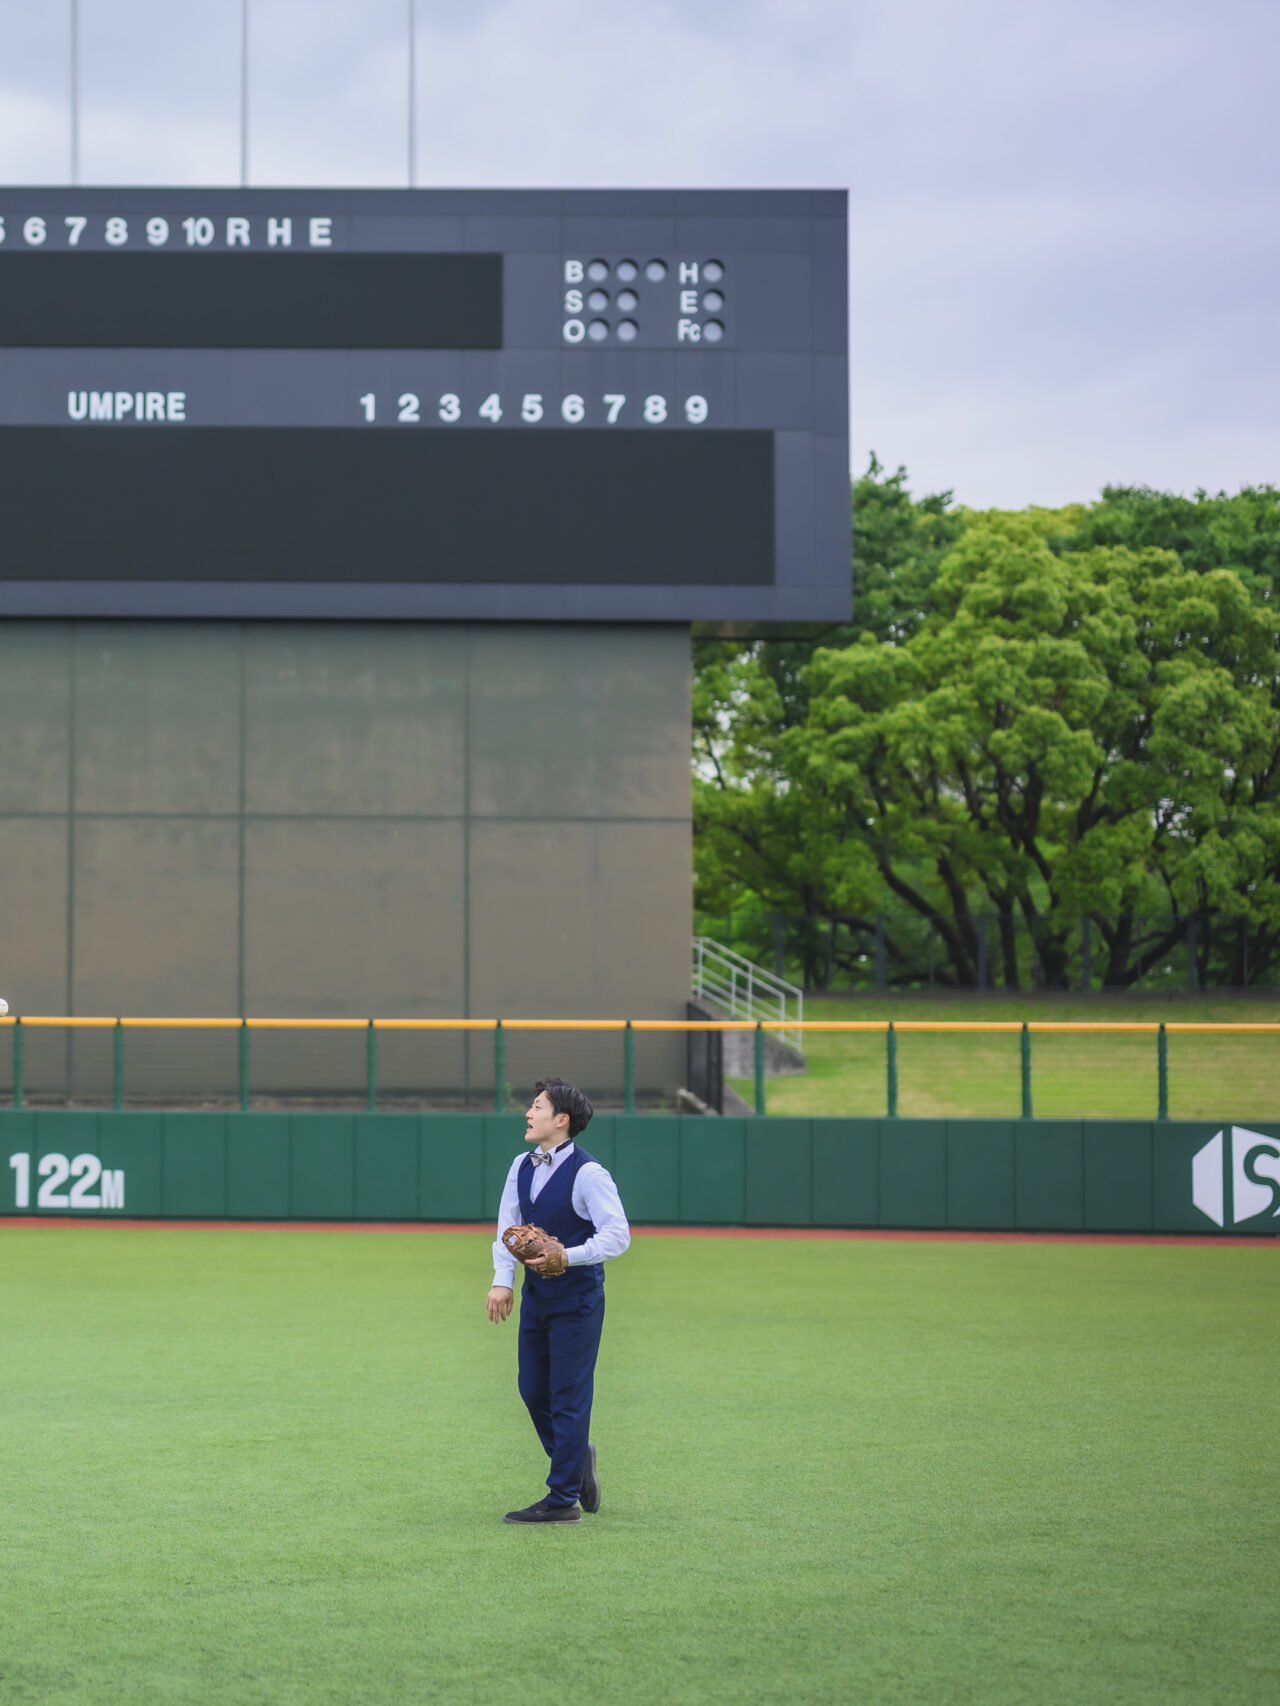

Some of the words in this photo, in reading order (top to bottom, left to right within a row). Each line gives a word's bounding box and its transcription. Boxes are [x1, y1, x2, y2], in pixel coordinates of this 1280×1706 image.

[22, 216, 47, 246] 6
[64, 216, 88, 246] 7
[104, 216, 129, 246] 8
[145, 216, 170, 247] 9
[181, 216, 215, 247] 10
[226, 217, 251, 247] R
[267, 217, 292, 247] H
[308, 217, 333, 248] E
[564, 259, 585, 284] B
[678, 261, 699, 285] H
[564, 289, 584, 314] S
[679, 290, 699, 314] E
[562, 318, 586, 346] O
[67, 390, 187, 422] UMPIRE
[359, 392, 376, 423] 1
[397, 392, 421, 423] 2
[438, 392, 462, 423] 3
[478, 393, 504, 423] 4
[521, 393, 544, 423] 5
[561, 393, 586, 424] 6
[602, 393, 627, 424] 7
[643, 394, 668, 424] 8
[684, 394, 709, 424] 9
[9, 1152, 125, 1208] 122M
